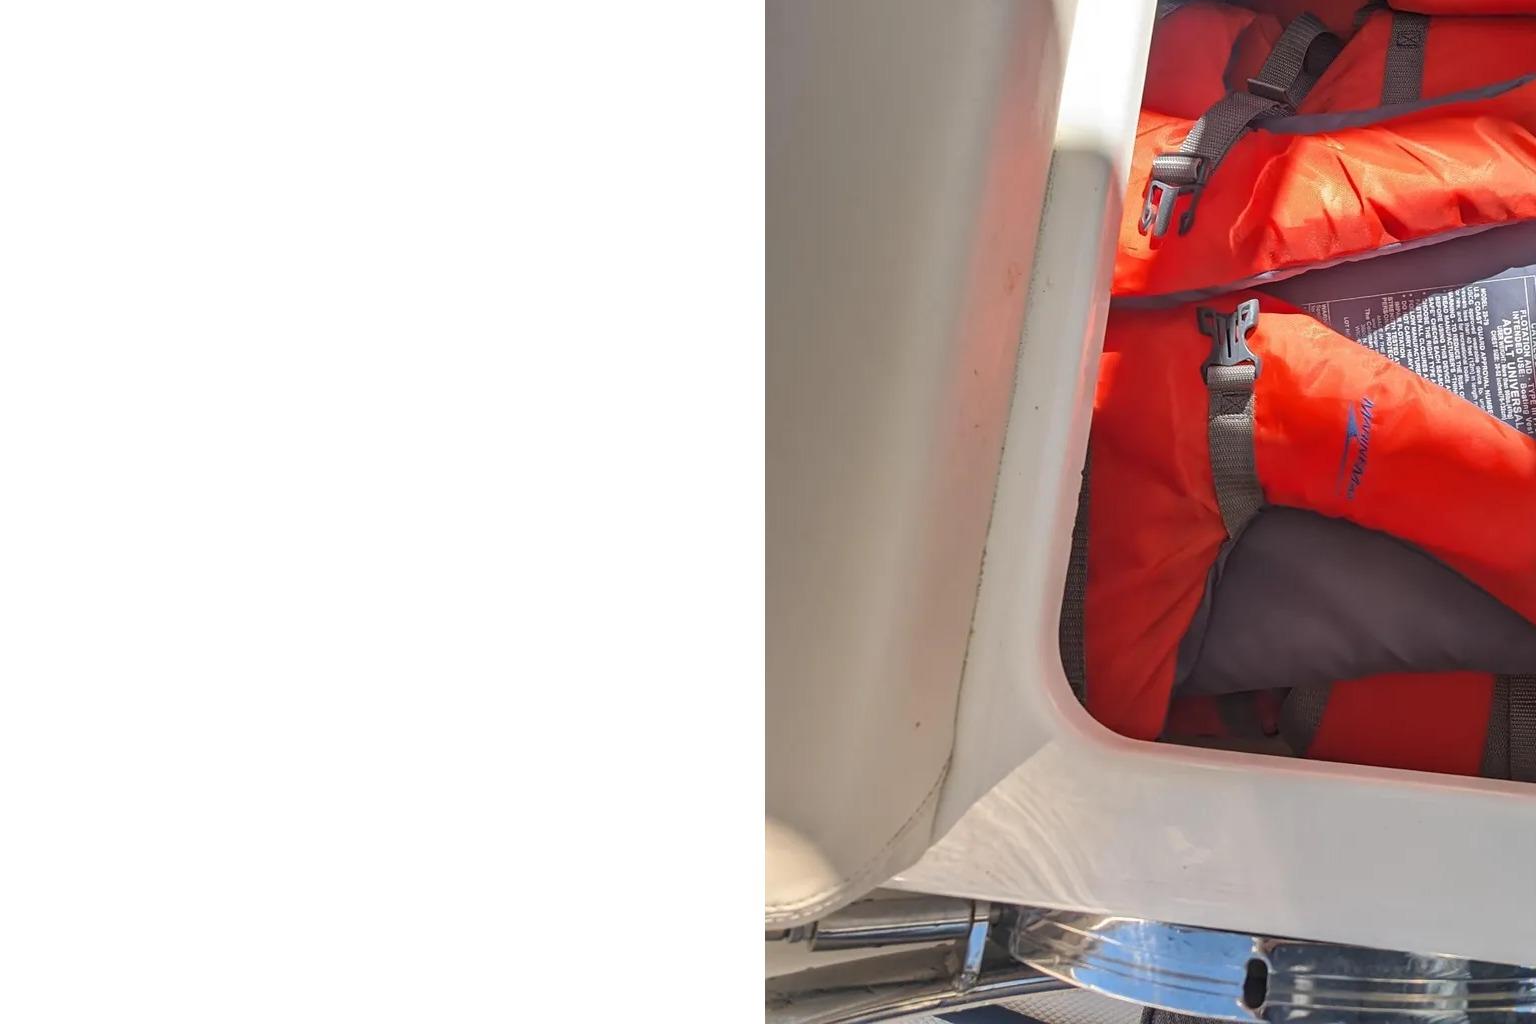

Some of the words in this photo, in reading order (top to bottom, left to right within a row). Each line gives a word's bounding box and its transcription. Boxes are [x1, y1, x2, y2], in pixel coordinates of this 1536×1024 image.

[1401, 300, 1406, 309] DO
[1397, 323, 1405, 358] FLOTATION
[1451, 323, 1457, 332] TO
[1474, 300, 1482, 325] COAST
[1480, 351, 1490, 388] APPROVAL
[1503, 318, 1514, 357] ADULT
[1512, 310, 1522, 354] INTENDED
[1516, 356, 1525, 377] USE:
[1519, 309, 1530, 357] FLOTATION
[1527, 383, 1536, 404] TYPE
[1508, 361, 1522, 428] UNIVERSAL
[1518, 382, 1530, 414] Boating
[1525, 417, 1533, 434] Vest
